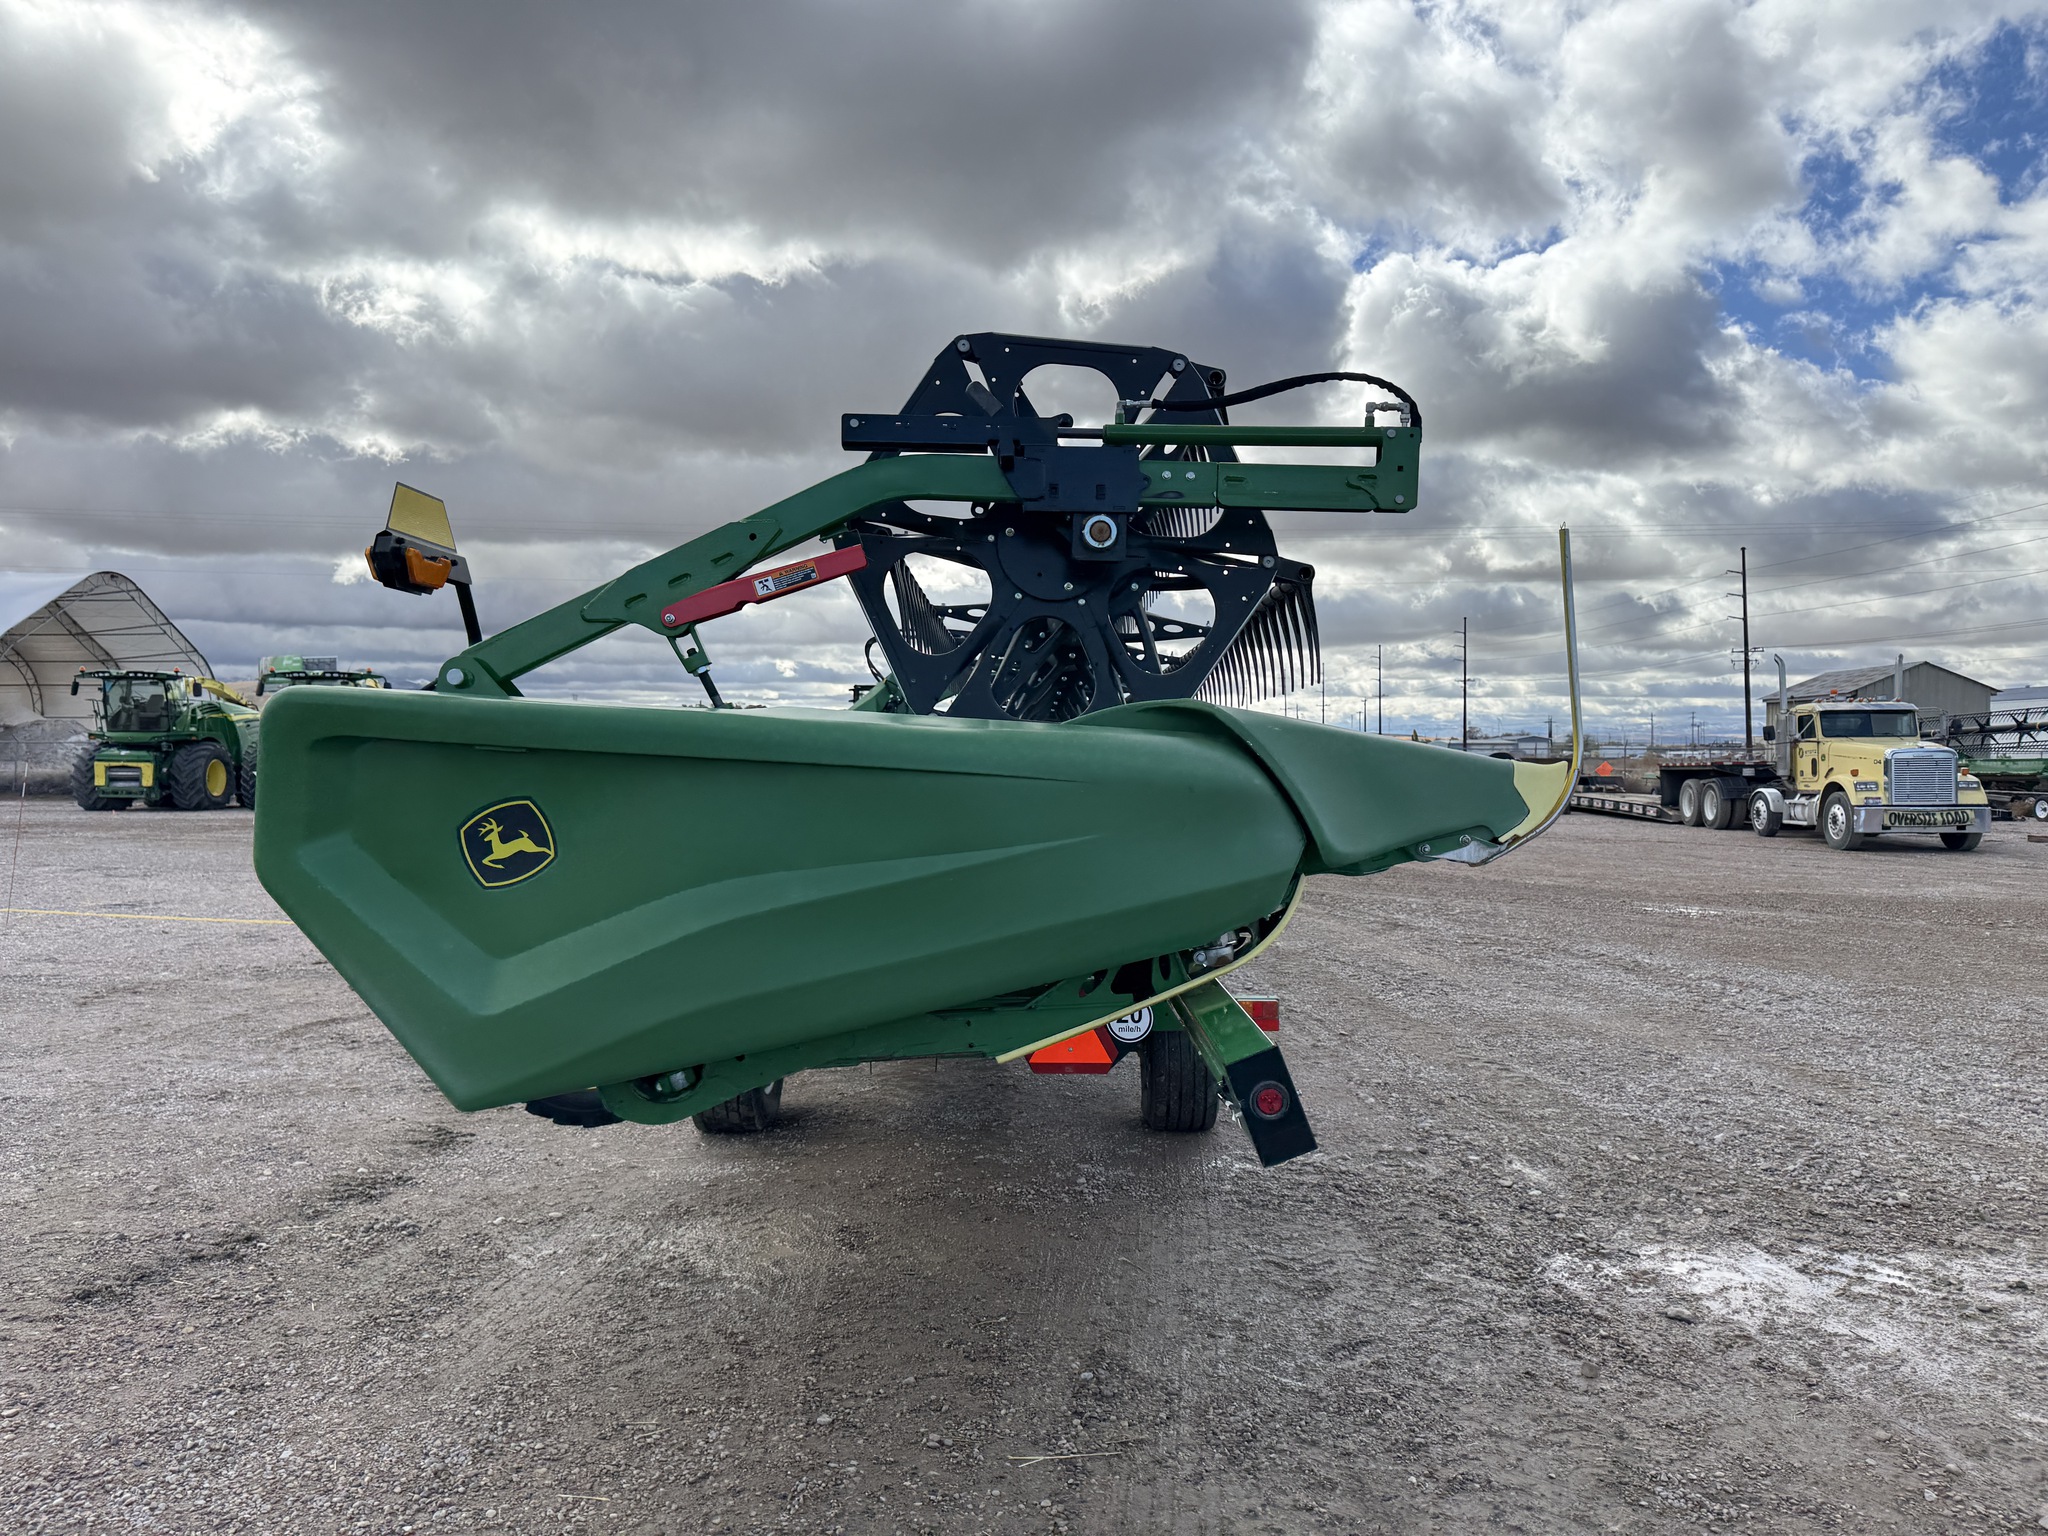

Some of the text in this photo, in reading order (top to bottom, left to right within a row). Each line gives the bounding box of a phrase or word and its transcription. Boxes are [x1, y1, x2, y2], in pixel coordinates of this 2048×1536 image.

[1888, 810, 1970, 826] OVERSIZE LOAD
[1118, 1025, 1141, 1033] mile/h
